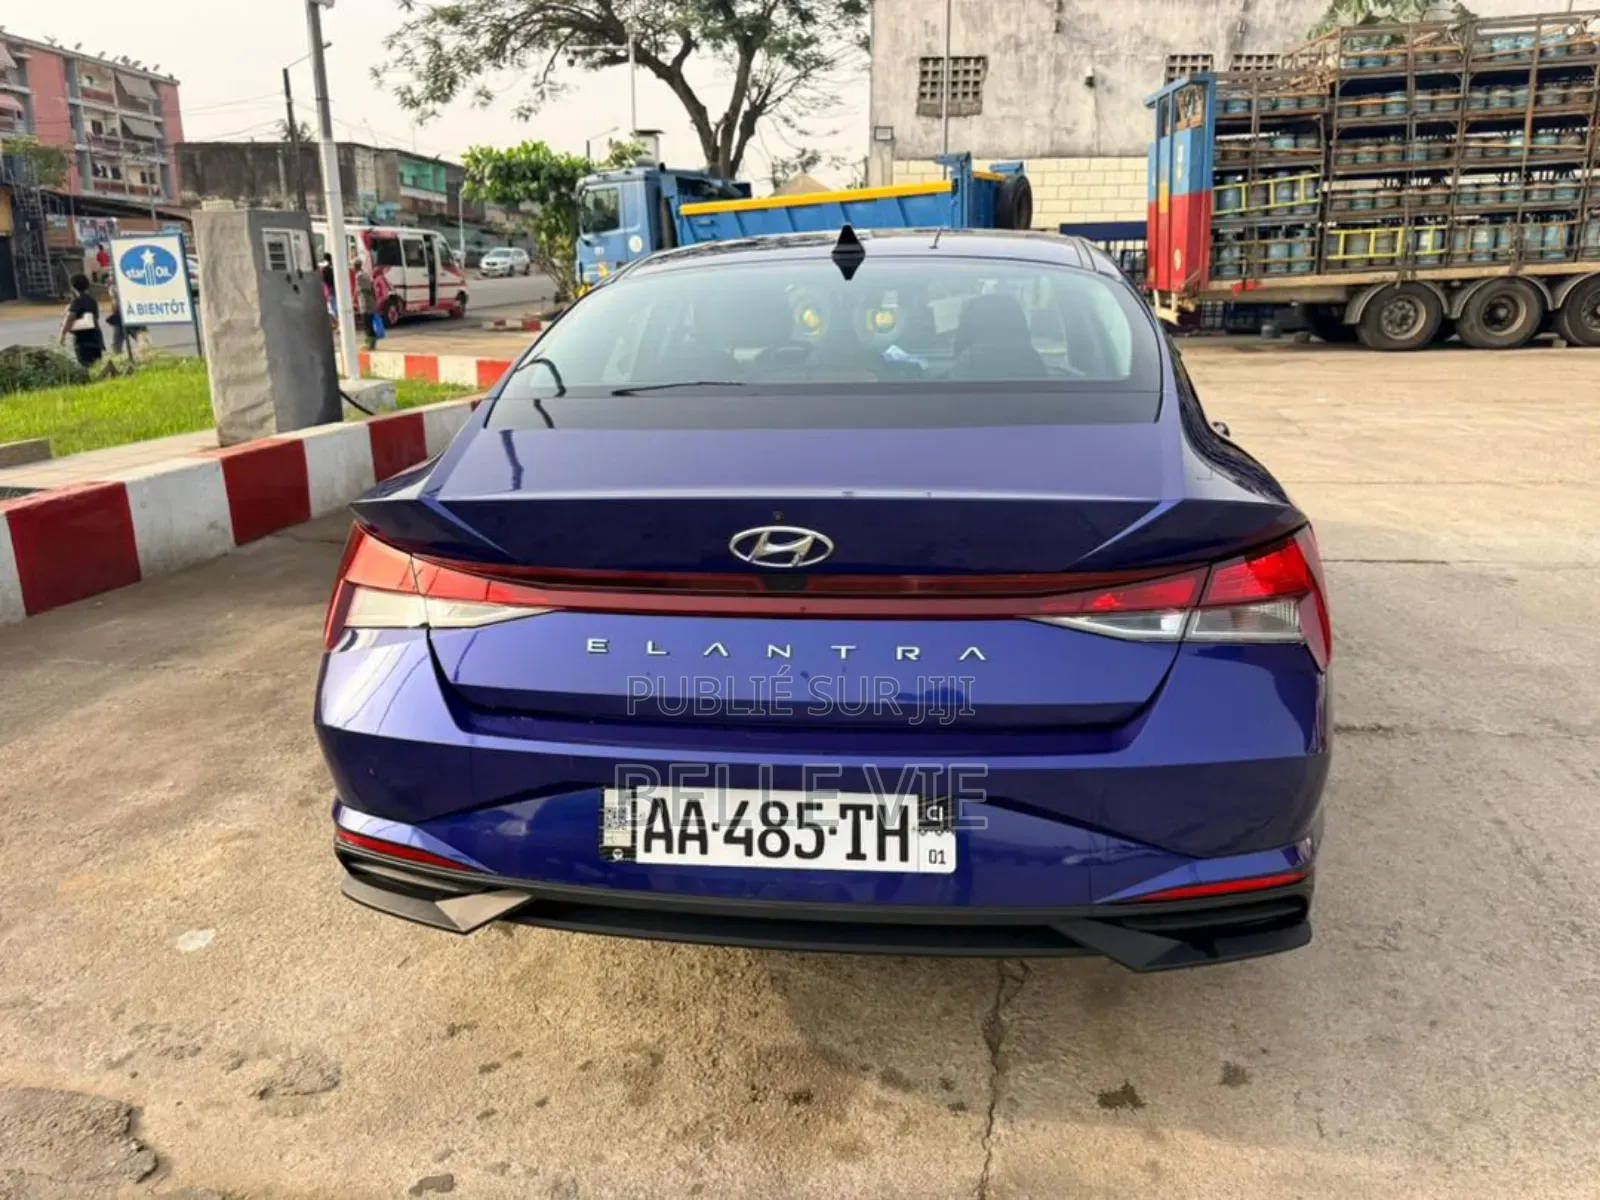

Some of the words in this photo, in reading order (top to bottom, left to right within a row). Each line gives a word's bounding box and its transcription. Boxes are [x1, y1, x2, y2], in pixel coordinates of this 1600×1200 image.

[127, 301, 135, 316] À
[136, 299, 185, 315] BIENTÔT
[586, 637, 987, 662] ELANTRA
[928, 848, 946, 865] 01
